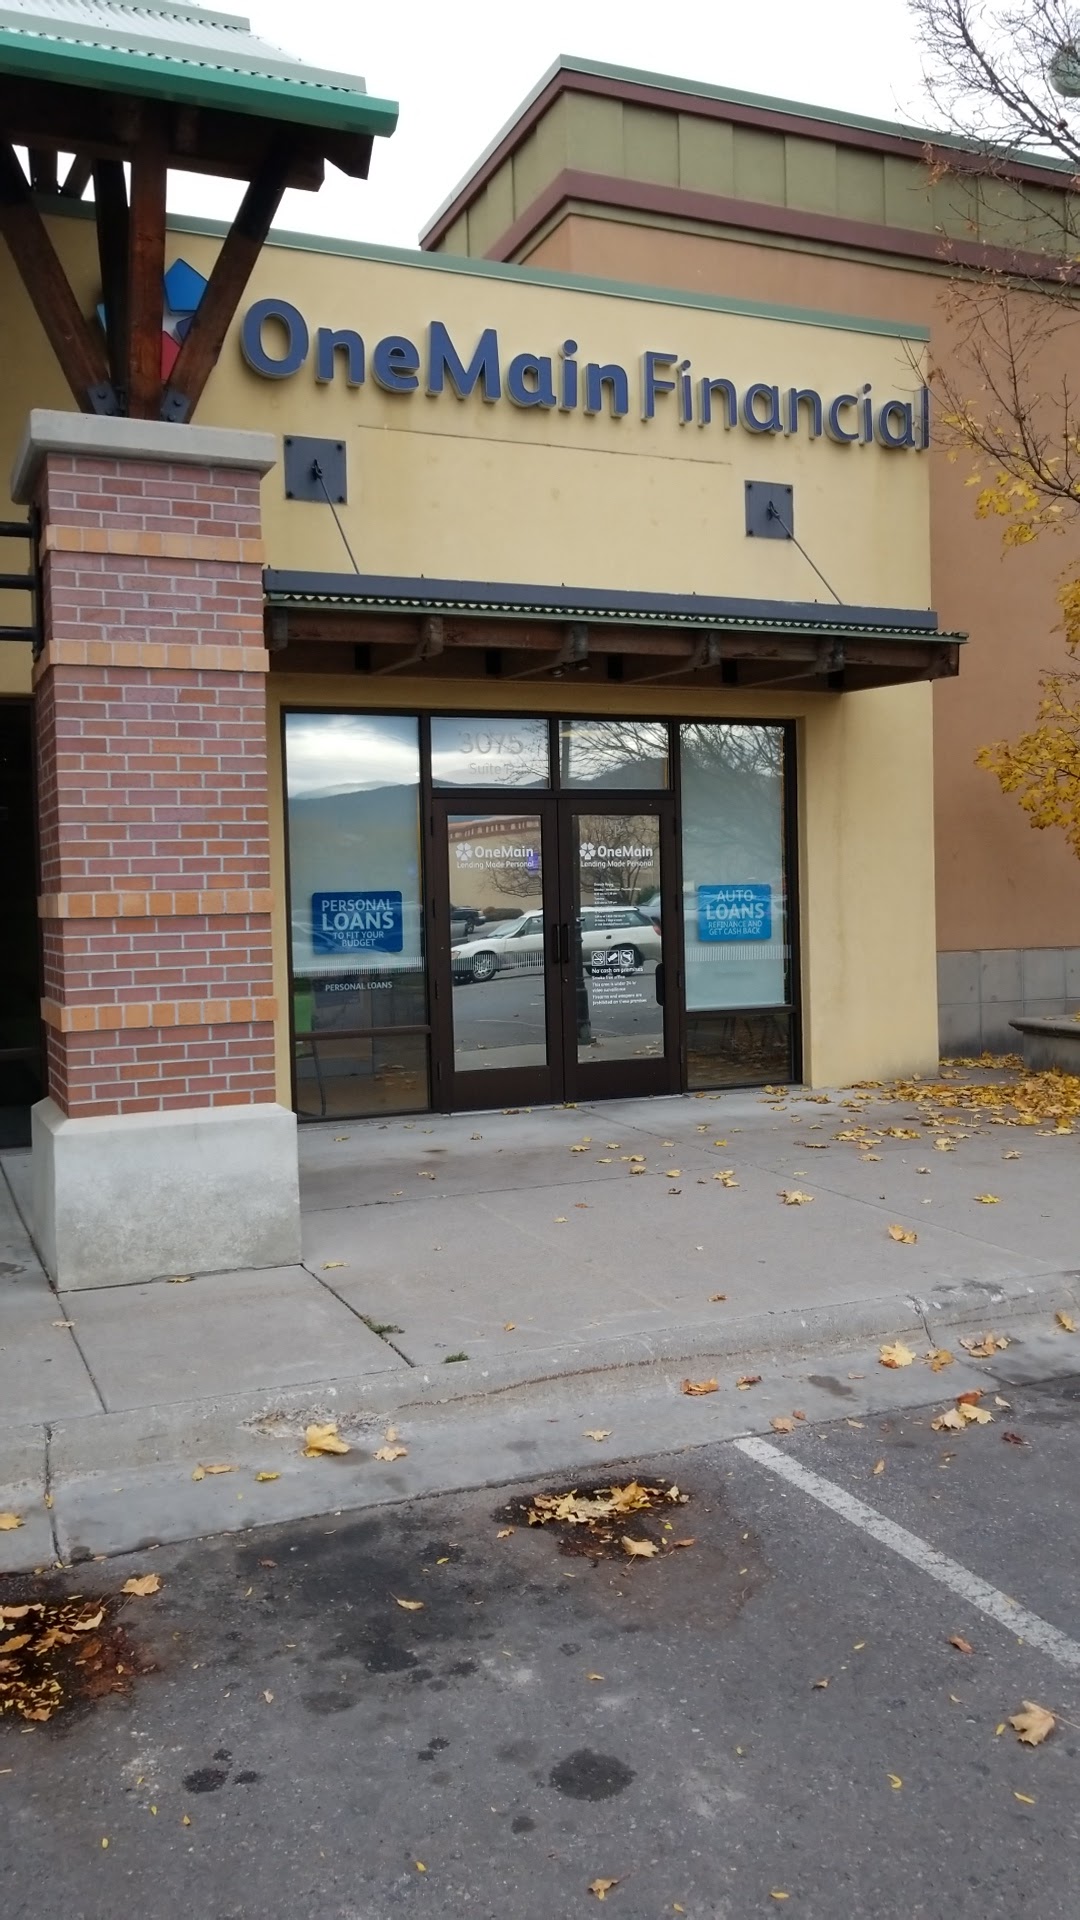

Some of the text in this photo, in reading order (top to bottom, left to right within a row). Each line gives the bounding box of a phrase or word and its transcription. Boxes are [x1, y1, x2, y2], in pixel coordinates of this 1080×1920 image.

[469, 762, 502, 775] Suite
[474, 845, 534, 858] OneMain
[597, 844, 653, 857] OneMain
[457, 861, 484, 869] Lending
[505, 860, 534, 868] Personal
[580, 860, 606, 869] Lending
[607, 860, 625, 868] Made
[716, 889, 754, 902] AUTO
[322, 898, 394, 912] PERSONAL
[706, 902, 765, 920] LOANS
[322, 911, 394, 931] LOANS
[708, 920, 746, 929] REFINANCE
[333, 930, 384, 940] TO FIT YOUR
[709, 927, 760, 936] GET CASH BACK
[342, 938, 376, 947] BUDGET
[325, 981, 393, 992] PERSONAL LOANS
